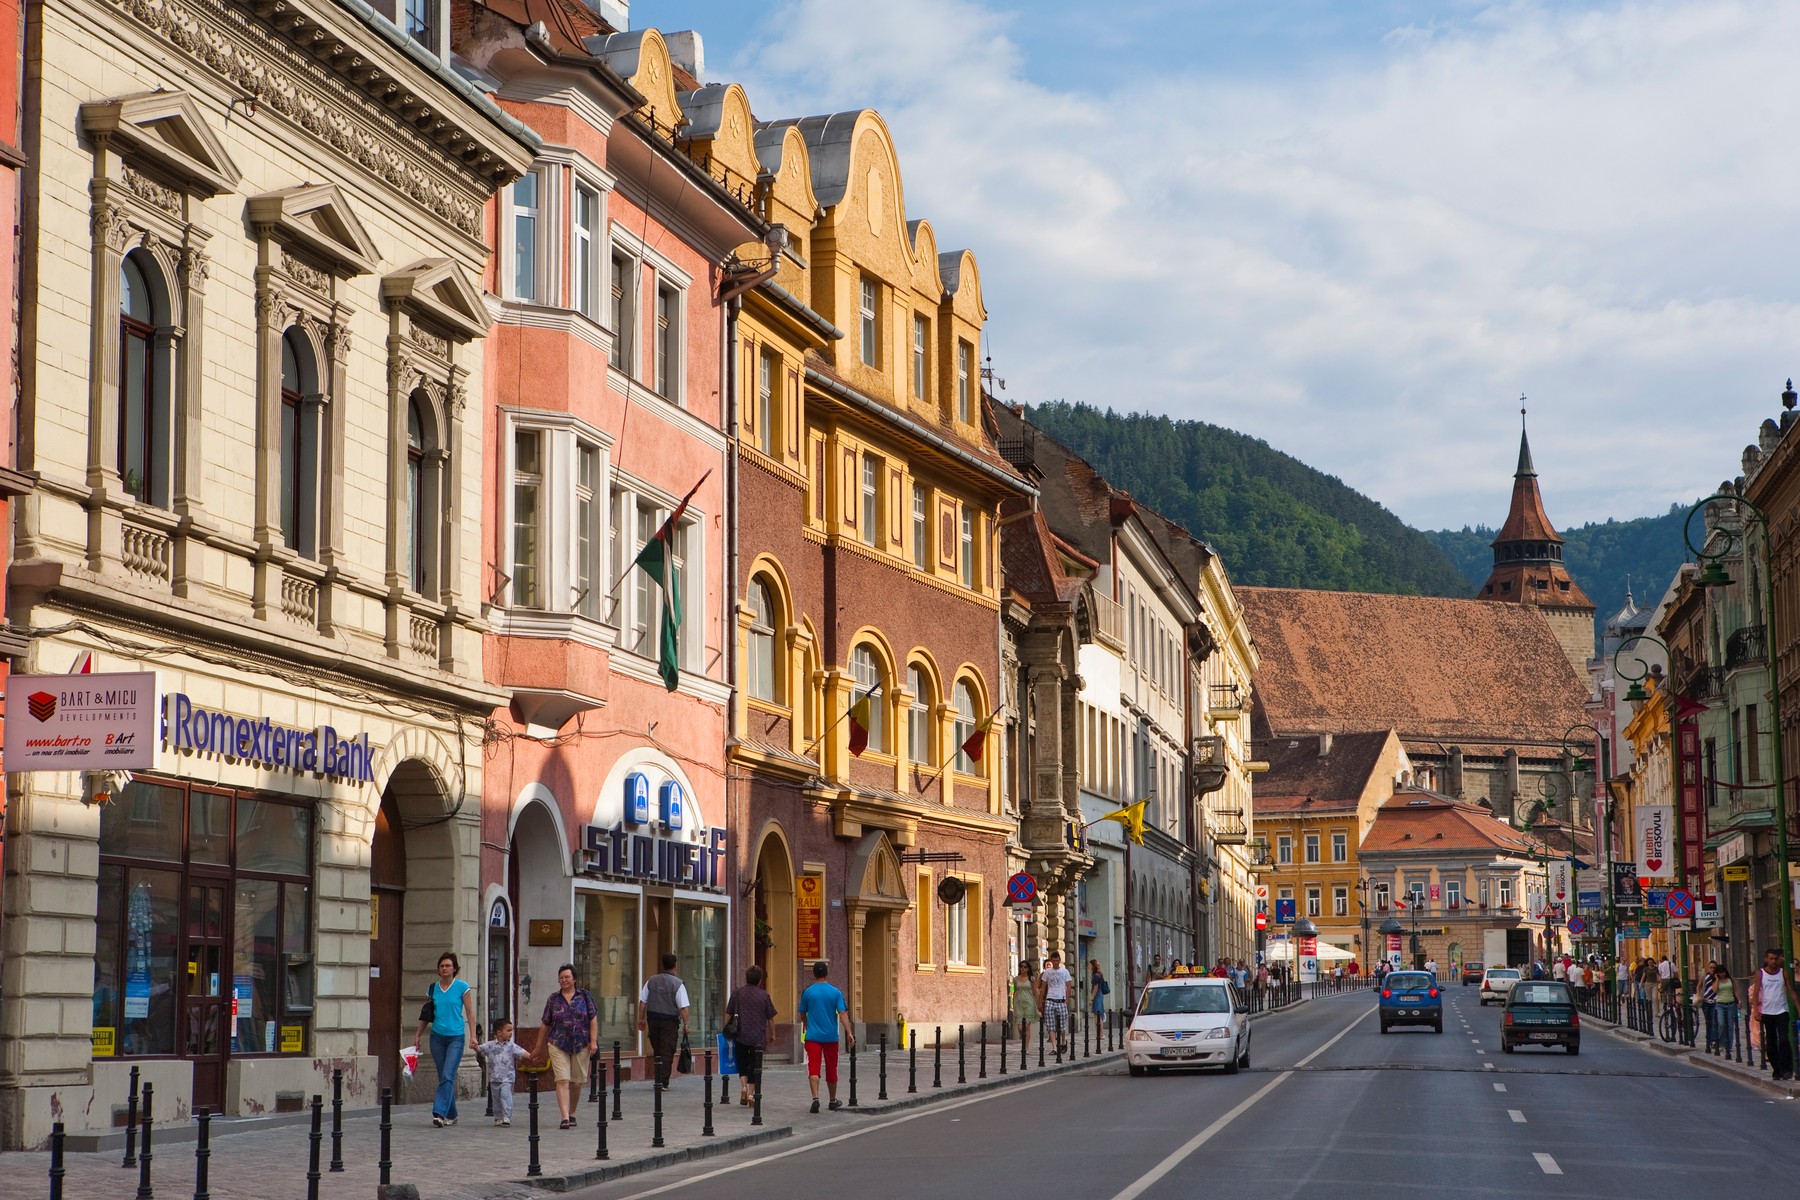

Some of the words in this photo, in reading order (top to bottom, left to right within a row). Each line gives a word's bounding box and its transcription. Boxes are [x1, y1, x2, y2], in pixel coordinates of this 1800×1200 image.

[60, 691, 91, 706] BART
[94, 692, 104, 704] &
[105, 690, 137, 705] MICU
[60, 712, 137, 722] DEVELOPMENTS
[25, 734, 92, 748] www.bart.ro
[175, 692, 316, 772] Romexterra
[323, 725, 376, 783] Bank
[104, 747, 135, 755] imobiliare
[798, 898, 820, 908] RALU
